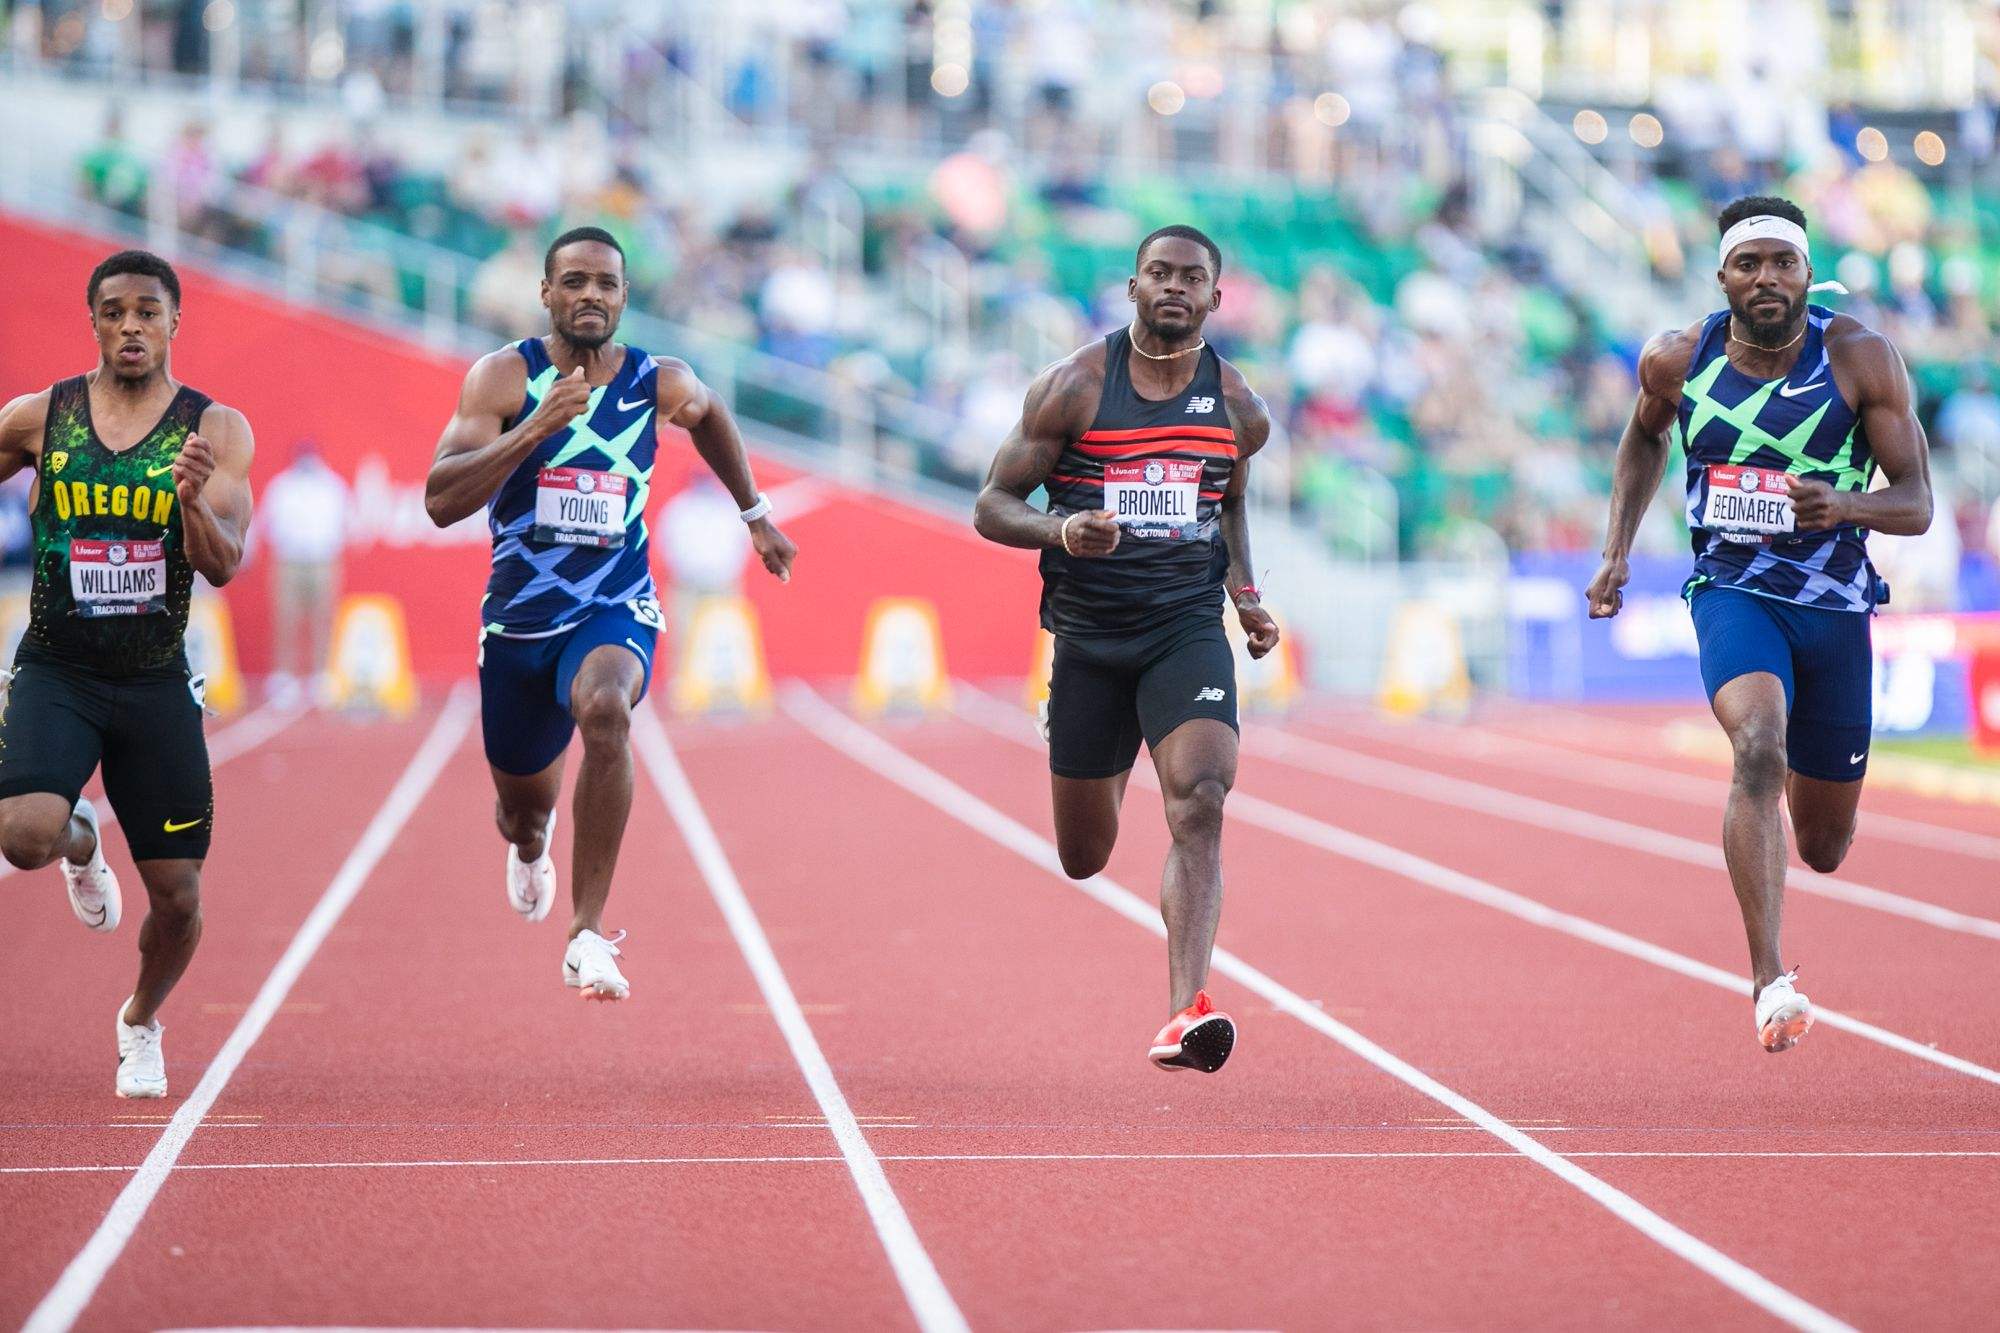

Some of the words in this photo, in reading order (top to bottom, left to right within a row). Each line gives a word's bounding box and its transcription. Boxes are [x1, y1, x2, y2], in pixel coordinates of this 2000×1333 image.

[53, 480, 175, 526] OREGON
[560, 496, 609, 525] YOUNG
[1118, 490, 1187, 516] BROMELL
[1713, 494, 1787, 525] BEDNAREK
[80, 567, 156, 594] WILLIAMS
